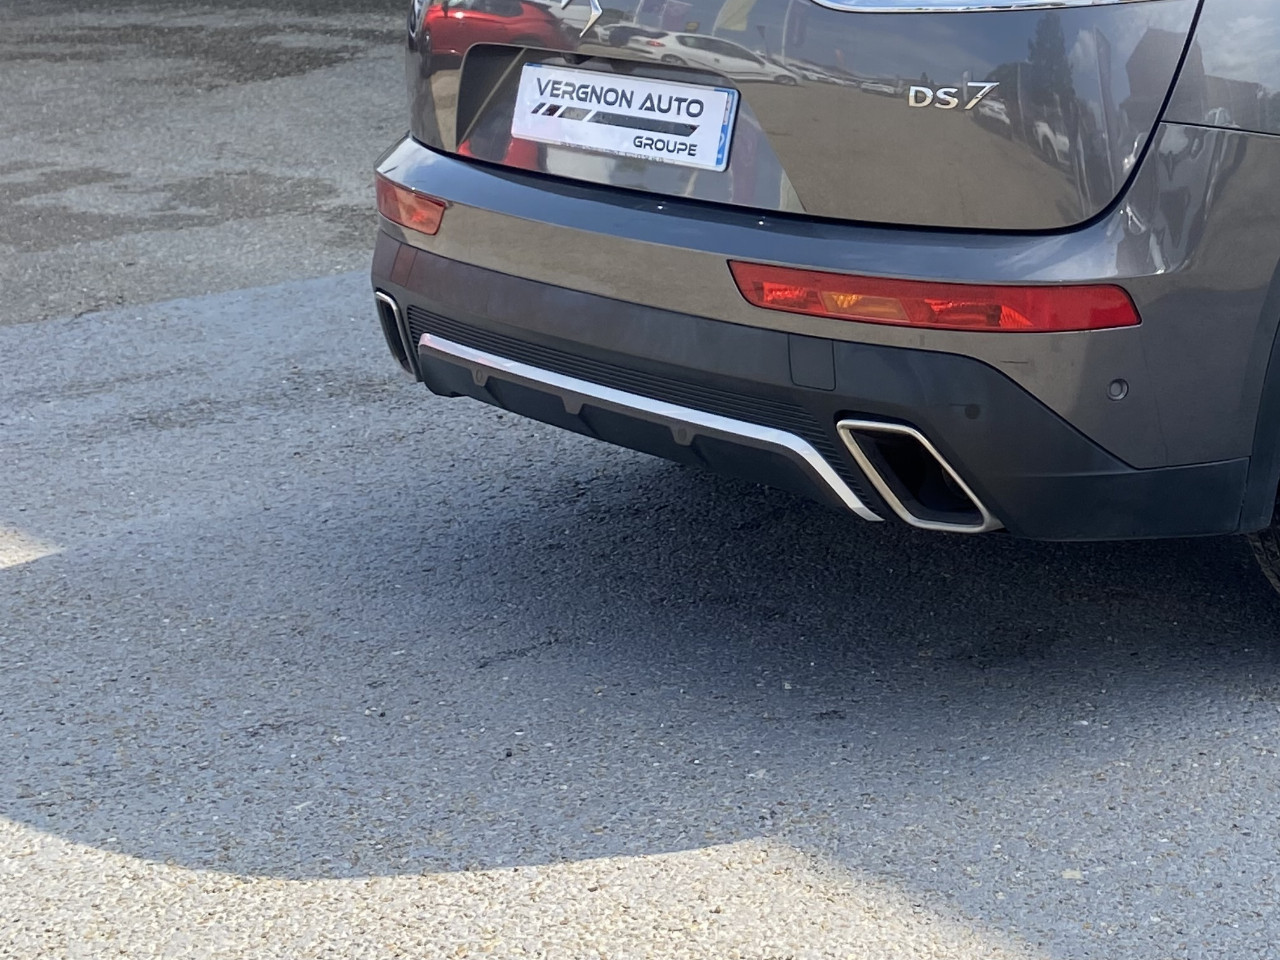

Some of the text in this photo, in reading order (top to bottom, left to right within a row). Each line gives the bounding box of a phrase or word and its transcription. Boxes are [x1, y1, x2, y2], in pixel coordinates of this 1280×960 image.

[536, 77, 704, 118] VERGNON AUTO
[633, 135, 698, 157] GROUPE
